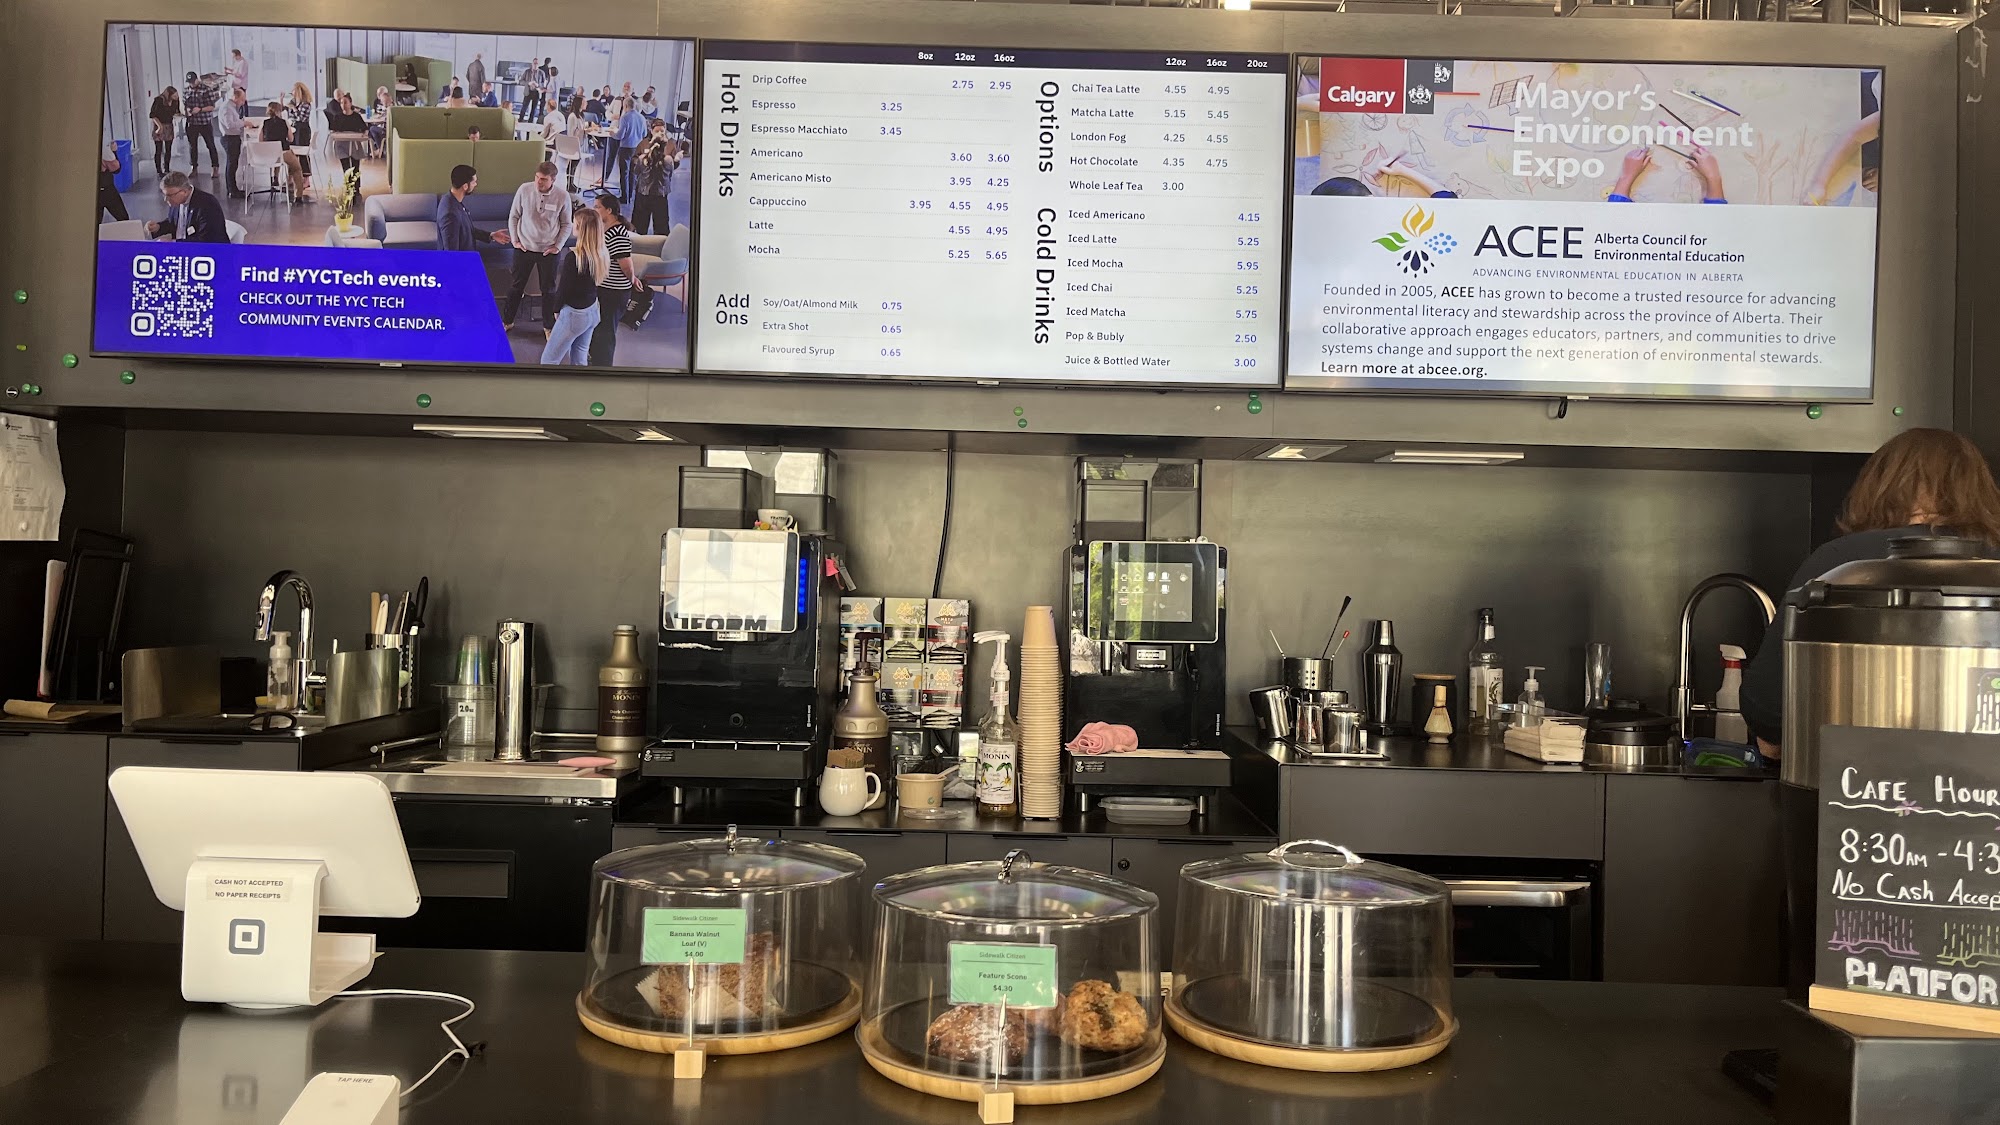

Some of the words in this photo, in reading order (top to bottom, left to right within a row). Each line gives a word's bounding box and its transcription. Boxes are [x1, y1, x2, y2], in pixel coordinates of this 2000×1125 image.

[917, 51, 933, 60] 8oz
[954, 52, 975, 61] 12oz
[994, 53, 1015, 62] 16oz
[1165, 57, 1186, 66] 12oz
[1206, 58, 1227, 67] 16oz
[1246, 59, 1268, 68] 20oz
[752, 74, 773, 85] Drip
[775, 75, 807, 84] Coffee
[952, 79, 974, 89] 2.75
[989, 80, 1011, 90] 2.95
[1071, 83, 1093, 92] Chai
[1095, 84, 1113, 93] Tea
[1115, 84, 1140, 94] Latte
[1164, 85, 1186, 94] 4.55
[1207, 86, 1230, 95] 4.95
[720, 73, 740, 114] Hot
[1328, 86, 1396, 106] Calgary
[752, 99, 796, 110] Espresso
[880, 102, 902, 112] 3.25
[1071, 107, 1106, 117] Matcha
[1109, 108, 1134, 118] Latte
[1164, 109, 1186, 118] 5.15
[1207, 110, 1229, 119] 5.45
[751, 123, 795, 134] Espresso
[797, 125, 848, 134] Macchiato
[879, 126, 902, 136] 3.45
[1035, 82, 1060, 172] Options
[1514, 116, 1753, 146] Environment
[719, 122, 740, 198] Drinks
[750, 148, 803, 158] Americano
[950, 152, 972, 162] 3.60
[987, 153, 1010, 163] 3.60
[1070, 156, 1087, 165] Hot
[1089, 156, 1138, 166] Chocolate
[1162, 157, 1184, 167] 4.35
[1205, 158, 1228, 168] 4.75
[1512, 150, 1604, 184] Expo
[749, 172, 802, 182] Americano
[805, 173, 832, 183] Misto
[949, 176, 972, 186] 3.95
[987, 177, 1009, 187] 4.25
[1069, 180, 1100, 190] Whole
[1103, 181, 1124, 190] Leaf
[1125, 181, 1143, 191] Tea
[1162, 181, 1184, 191] 3.00
[749, 196, 806, 207] Cappuccino
[909, 200, 931, 209] 3.95
[948, 201, 971, 210] 4.55
[986, 202, 1009, 211] 4.95
[1068, 209, 1090, 219] Iced
[1092, 210, 1145, 220] Americano
[1237, 212, 1260, 222] 4.15
[749, 220, 774, 230] Latte
[948, 225, 970, 234] 4.55
[985, 226, 1008, 236] 4.95
[1036, 208, 1056, 260] Cold
[1473, 224, 1584, 260] ACEE
[1594, 232, 1639, 244] Alberta
[1642, 234, 1686, 245] Council
[1689, 234, 1707, 246] for
[748, 245, 780, 254] Mocha
[948, 249, 970, 259] 5.25
[985, 250, 1007, 260] 5.65
[1594, 249, 1682, 261] Environmental
[1685, 250, 1744, 262] Education
[1067, 258, 1089, 267] Iced
[1091, 259, 1123, 268] Mocha
[1237, 261, 1259, 270] 5.95
[240, 266, 279, 282] Find
[282, 268, 374, 286] #YYCTech
[378, 273, 442, 288] events.
[1472, 268, 1531, 278] ADVANCING
[1536, 269, 1619, 280] ENVIRONMENTAL
[1624, 271, 1681, 281] EDUCATION
[1686, 272, 1696, 281] IN
[1701, 273, 1743, 282] ALBERTA
[239, 292, 282, 305] CHECK
[285, 293, 313, 305] OUT
[315, 294, 340, 306] THE
[343, 295, 368, 307] YYC
[371, 296, 404, 308] TECH
[715, 293, 749, 308] Add
[1324, 283, 1381, 296] Founded
[1385, 284, 1396, 296] in
[1400, 284, 1436, 299] 2005,
[1440, 286, 1474, 298] ACEE
[1478, 286, 1501, 299] has
[1504, 289, 1545, 302] grown
[1549, 289, 1563, 300] to
[1567, 288, 1619, 301] become
[1623, 292, 1630, 301] a
[1634, 290, 1682, 303] trusted
[1686, 293, 1743, 304] resource
[1747, 291, 1766, 304] for
[1769, 292, 1836, 308] advancing
[1034, 270, 1056, 344] Drinks
[1066, 306, 1088, 316] Iced
[1090, 307, 1126, 317] Matcha
[1235, 309, 1257, 319] 5.75
[238, 312, 320, 326] COMMUNITY
[323, 315, 370, 328] EVENTS
[374, 316, 445, 330] CALENDAR.
[715, 310, 748, 325] Ons
[1065, 331, 1084, 342] Pop
[1086, 331, 1094, 340] &
[1096, 331, 1124, 343] Bubly
[1234, 334, 1257, 343] 2.50
[1064, 355, 1091, 364] Juice
[1093, 356, 1100, 365] &
[1103, 356, 1138, 366] Bottled
[1141, 357, 1170, 366] Water
[1234, 358, 1256, 367] 3.00
[1322, 362, 1358, 374] Learn
[1362, 365, 1398, 374] more
[1400, 364, 1415, 375] at
[1418, 364, 1488, 378] abcee.org.
[1832, 869, 1864, 897] No
[978, 971, 1005, 979] Feature
